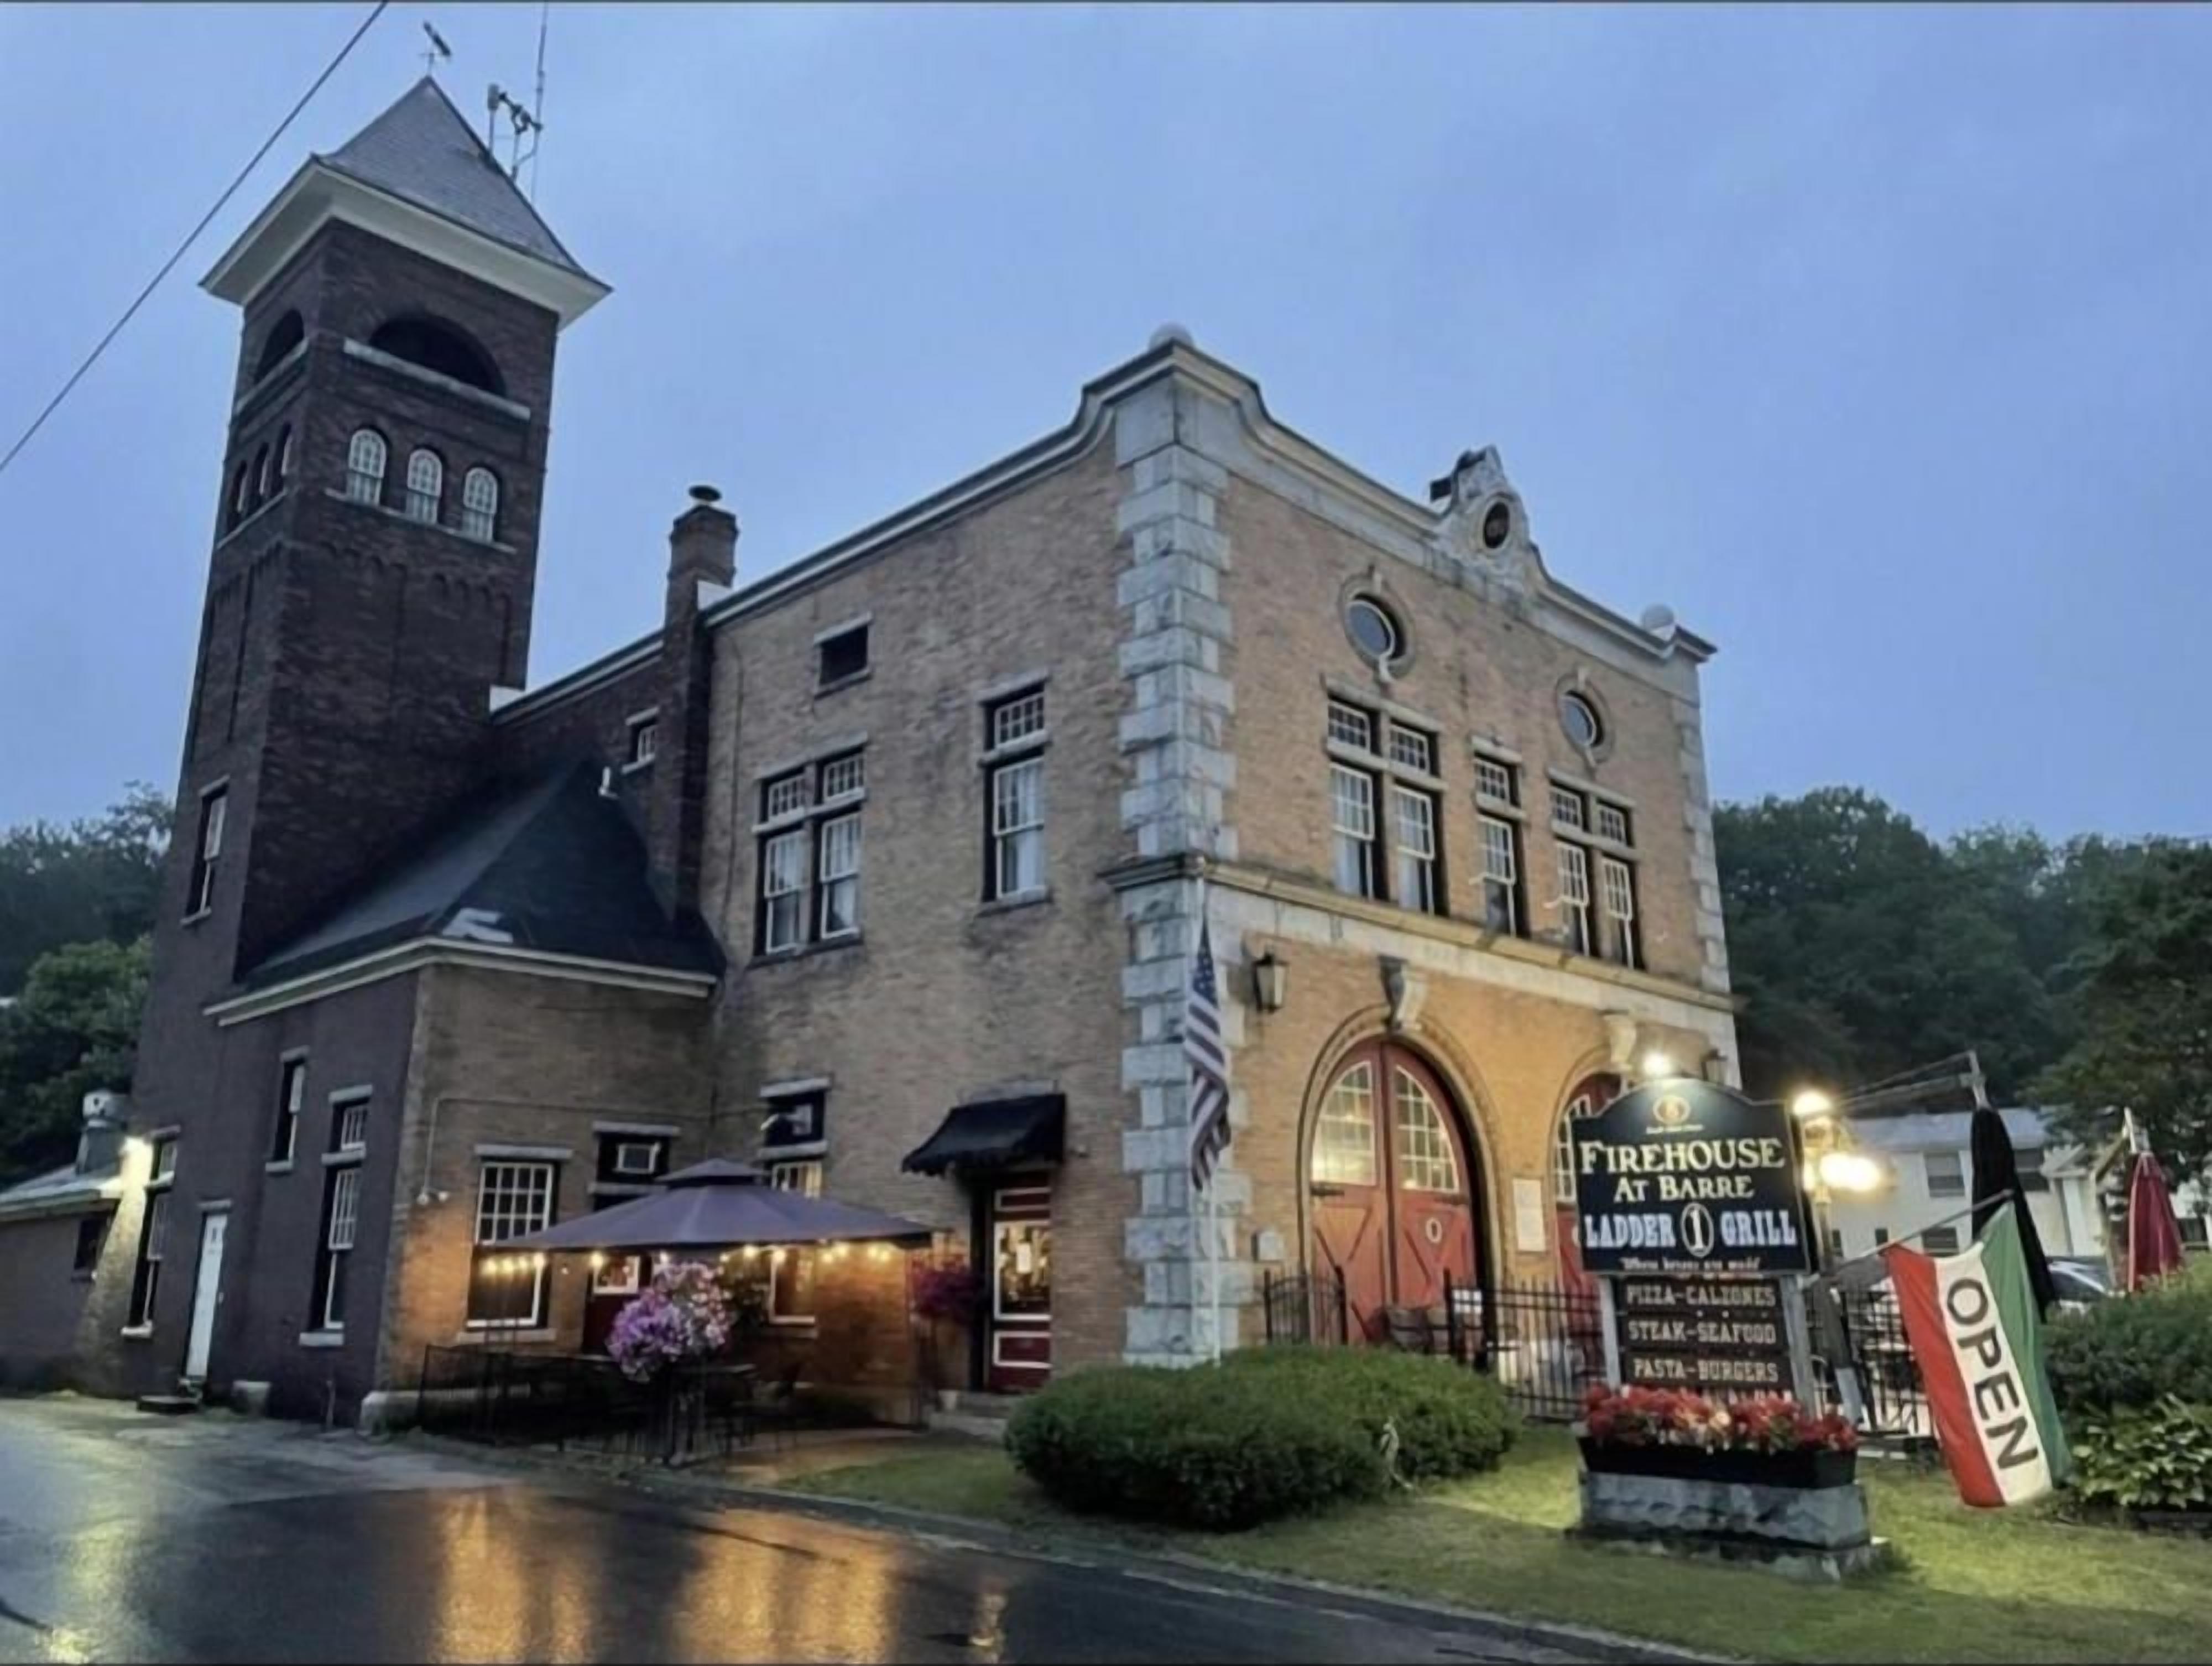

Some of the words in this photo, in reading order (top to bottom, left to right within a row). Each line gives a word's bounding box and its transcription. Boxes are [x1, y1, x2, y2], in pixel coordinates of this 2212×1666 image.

[1579, 1138, 1785, 1174] FIREHOUSE
[1614, 1177, 1649, 1203] AT
[1658, 1175, 1755, 1201] BARRE
[1585, 1214, 1676, 1248] LADDER
[1720, 1210, 1797, 1246] GRILL
[1947, 1279, 2038, 1469] OPEN
